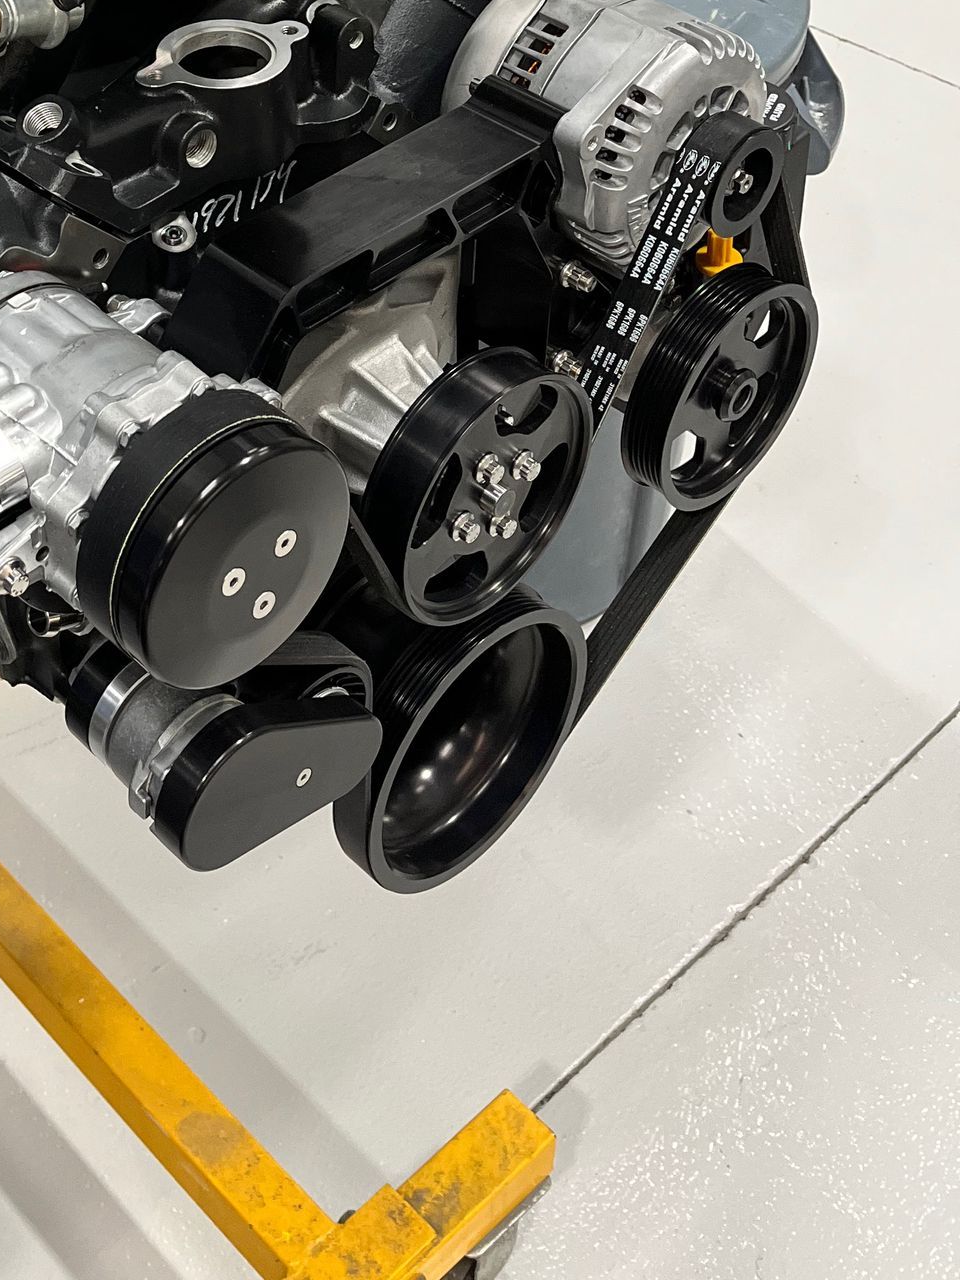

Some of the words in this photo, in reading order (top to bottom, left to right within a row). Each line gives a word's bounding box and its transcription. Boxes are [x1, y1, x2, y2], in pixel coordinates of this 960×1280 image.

[653, 177, 681, 230] Aramid
[665, 183, 694, 236] Aramid
[677, 189, 706, 243] Aramid
[629, 234, 657, 279] K060664A
[641, 240, 669, 285] K060664A
[653, 246, 680, 292] K060664A
